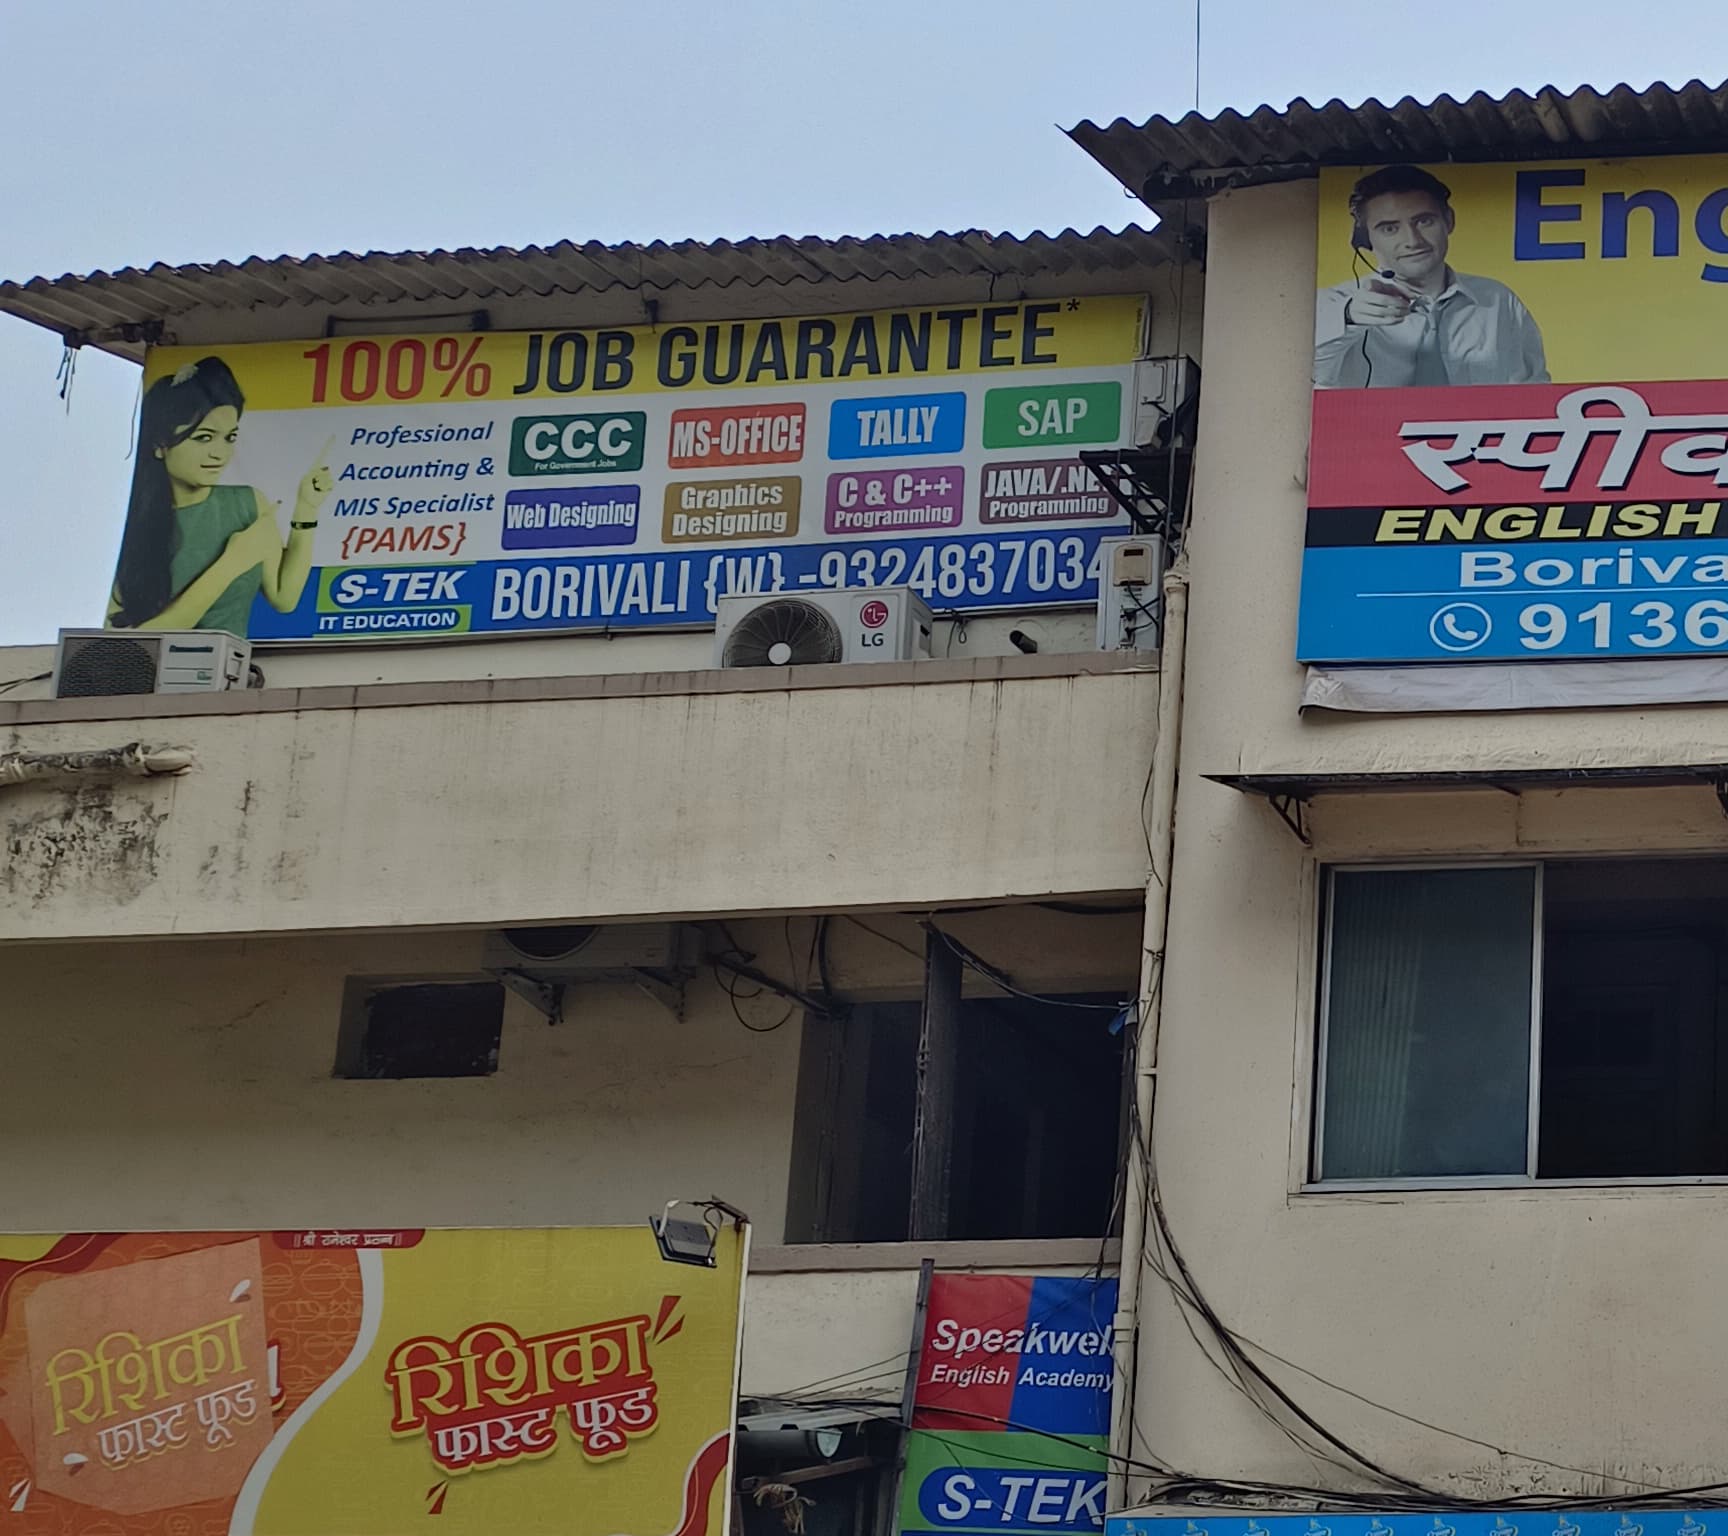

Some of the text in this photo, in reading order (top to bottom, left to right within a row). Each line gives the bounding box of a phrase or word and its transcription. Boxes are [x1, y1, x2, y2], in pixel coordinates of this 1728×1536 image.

[303, 336, 491, 403] 100%
[514, 330, 635, 395] JOB
[350, 421, 494, 446] Professional
[857, 406, 940, 447] TALLY
[1018, 397, 1088, 437] SAP
[524, 419, 633, 460] CCC
[672, 414, 803, 458] MS-OFFICE
[339, 457, 495, 482] Accounting &
[334, 493, 495, 519] MIS Specialist
[681, 483, 783, 510] Graphics
[838, 472, 952, 508] C & C++
[990, 495, 1109, 519] Programming
[507, 500, 636, 529] Web Designing
[672, 510, 787, 537] Designing
[834, 504, 953, 528] Programming
[1373, 500, 1727, 545] ENGLISH
[341, 522, 467, 560] {PAMS}
[336, 570, 467, 603] S-TEK
[492, 559, 690, 621] BORIVALI
[318, 612, 456, 630] IT EDUCATION
[862, 634, 885, 648] LG
[932, 1319, 1115, 1359] Speakwel
[45, 1314, 247, 1437] रिशिका
[390, 1320, 646, 1425] रिशिका
[930, 1364, 1114, 1392] English Academy
[434, 1386, 653, 1462] फास्ट फूड
[937, 1473, 1108, 1525] S-TEK
